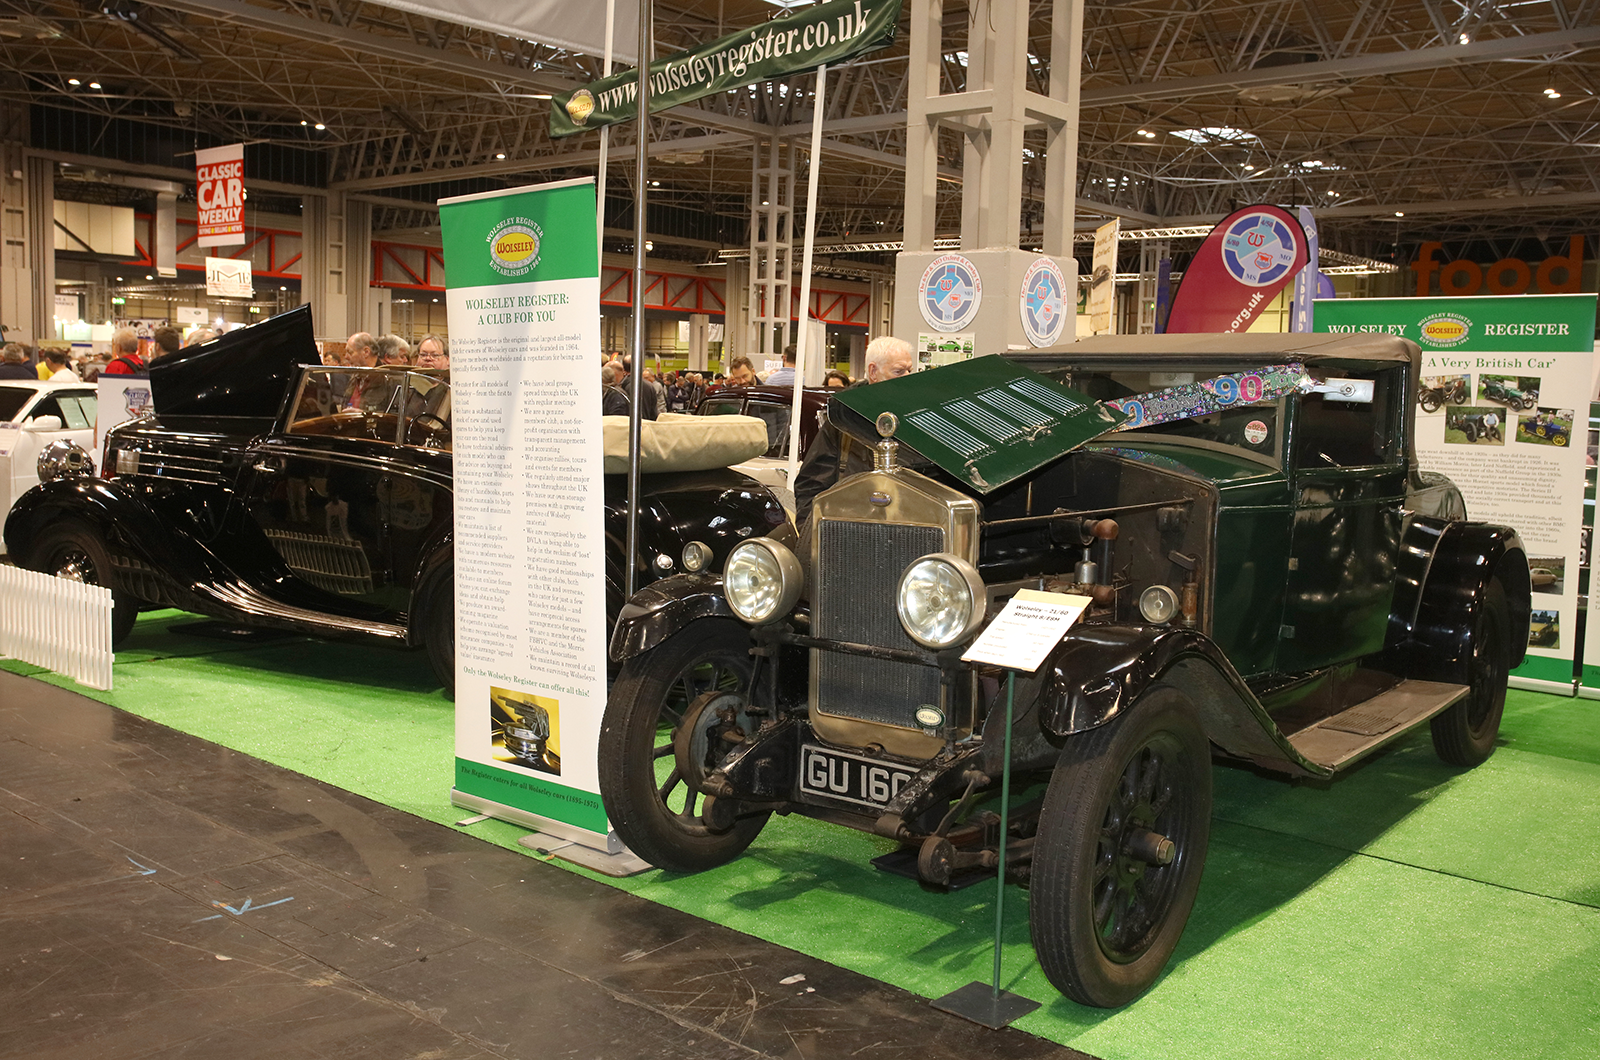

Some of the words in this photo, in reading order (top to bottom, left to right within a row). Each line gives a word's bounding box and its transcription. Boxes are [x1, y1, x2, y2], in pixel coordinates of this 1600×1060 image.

[198, 162, 241, 182] CLASSIC
[198, 178, 242, 210] CAR
[198, 207, 242, 225] WEEKLY
[486, 218, 515, 243] WOLSELEY
[516, 217, 544, 239] REGISTER
[497, 241, 534, 255] WOLSELEY
[489, 259, 529, 277] ESTABLISHED
[1410, 235, 1584, 296] food
[465, 296, 515, 310] WOLSELEY
[518, 293, 570, 307] REGISTER:
[478, 316, 484, 325] A
[486, 314, 512, 325] CLUB
[514, 312, 534, 323] FOR
[536, 311, 556, 322] YOU
[1417, 312, 1446, 327] WOLSELEY
[1447, 312, 1473, 327] REGISTER
[1426, 326, 1462, 334] WOLSELEY
[1484, 324, 1569, 336] REGISTER
[1419, 336, 1457, 348] ESTABLISHED
[1428, 358, 1437, 367] A
[1440, 358, 1470, 369] Very
[1476, 358, 1522, 368] British
[1214, 375, 1263, 405] 90
[464, 665, 476, 678] Only
[477, 667, 487, 677] the
[488, 670, 512, 685] Wolseley
[513, 674, 537, 690] Register
[551, 682, 565, 692] offer
[566, 685, 574, 694] all
[575, 687, 589, 697] this!
[808, 754, 848, 794] GU
